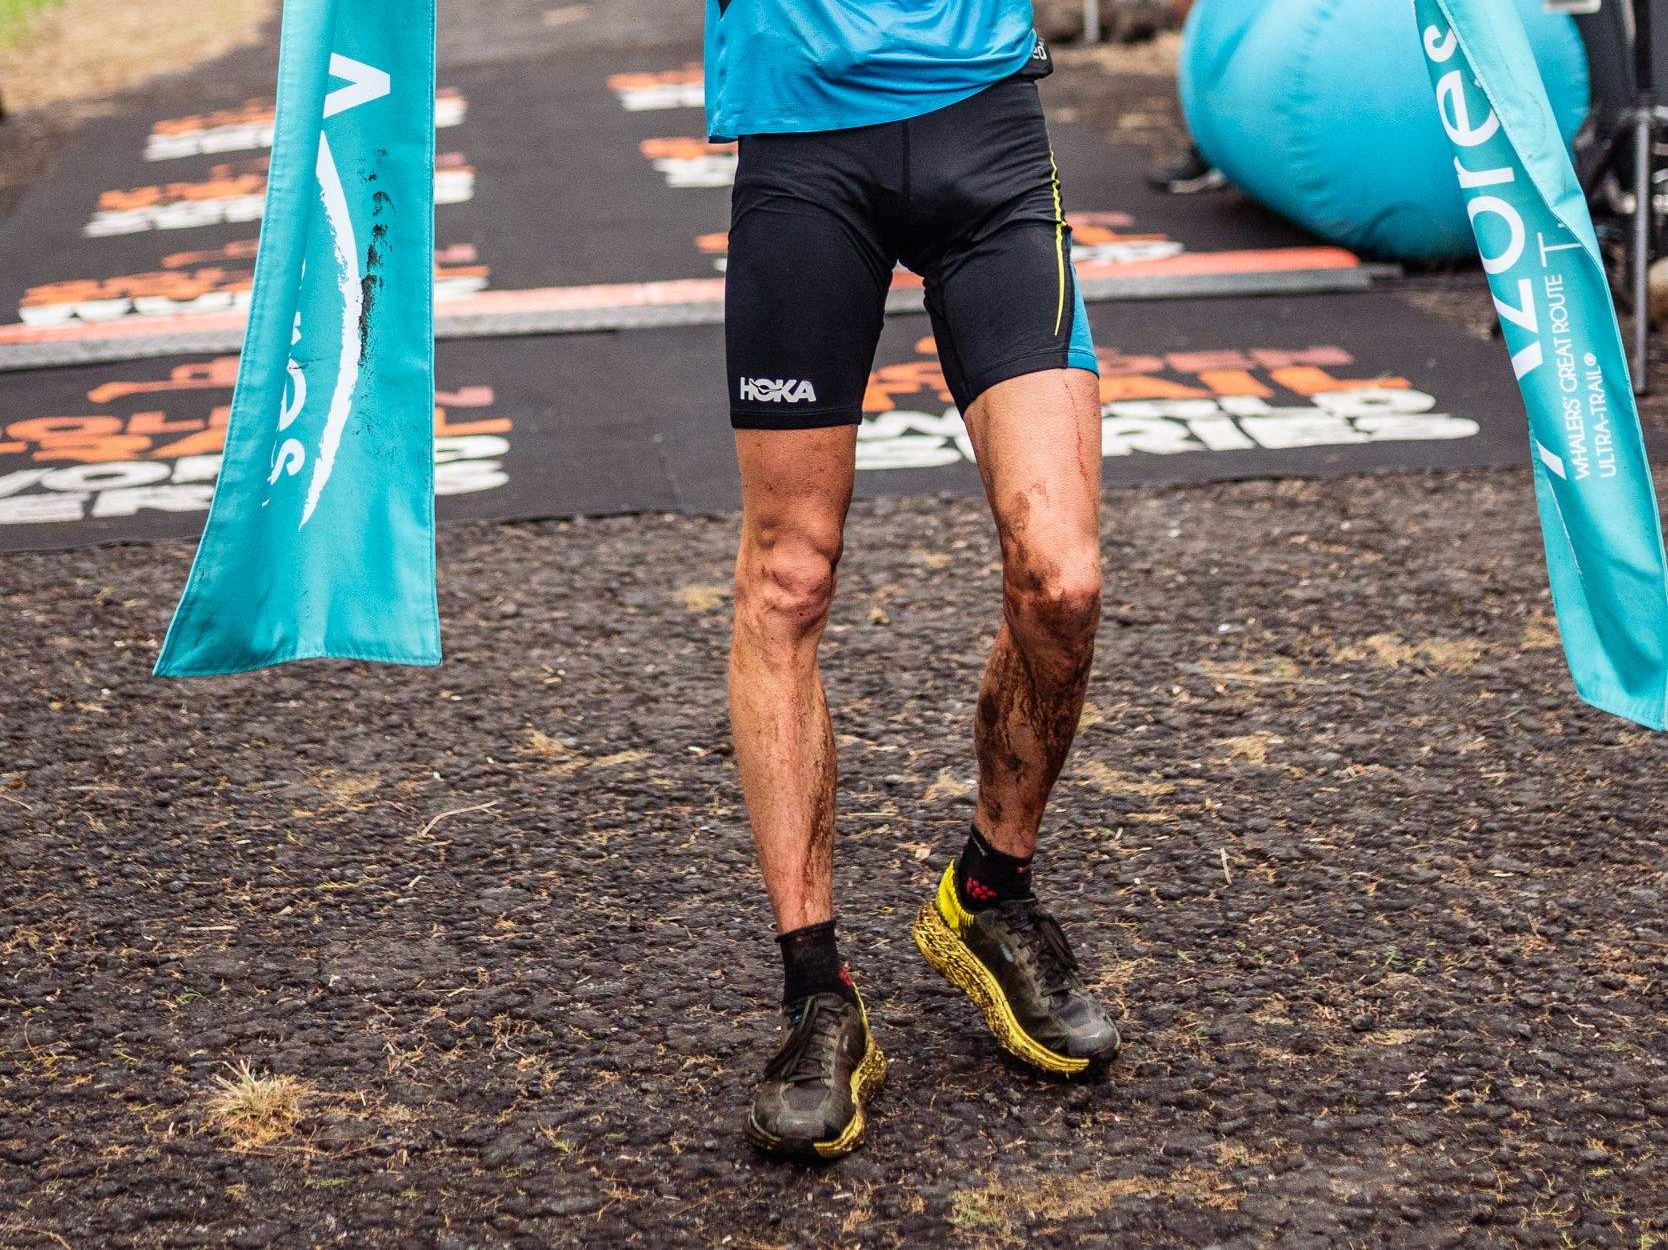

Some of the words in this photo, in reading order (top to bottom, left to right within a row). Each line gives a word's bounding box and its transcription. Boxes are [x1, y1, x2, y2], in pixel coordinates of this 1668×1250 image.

[1544, 273, 1570, 334] ROUTE
[740, 376, 817, 403] HOKA
[1554, 337, 1578, 393] GREAT
